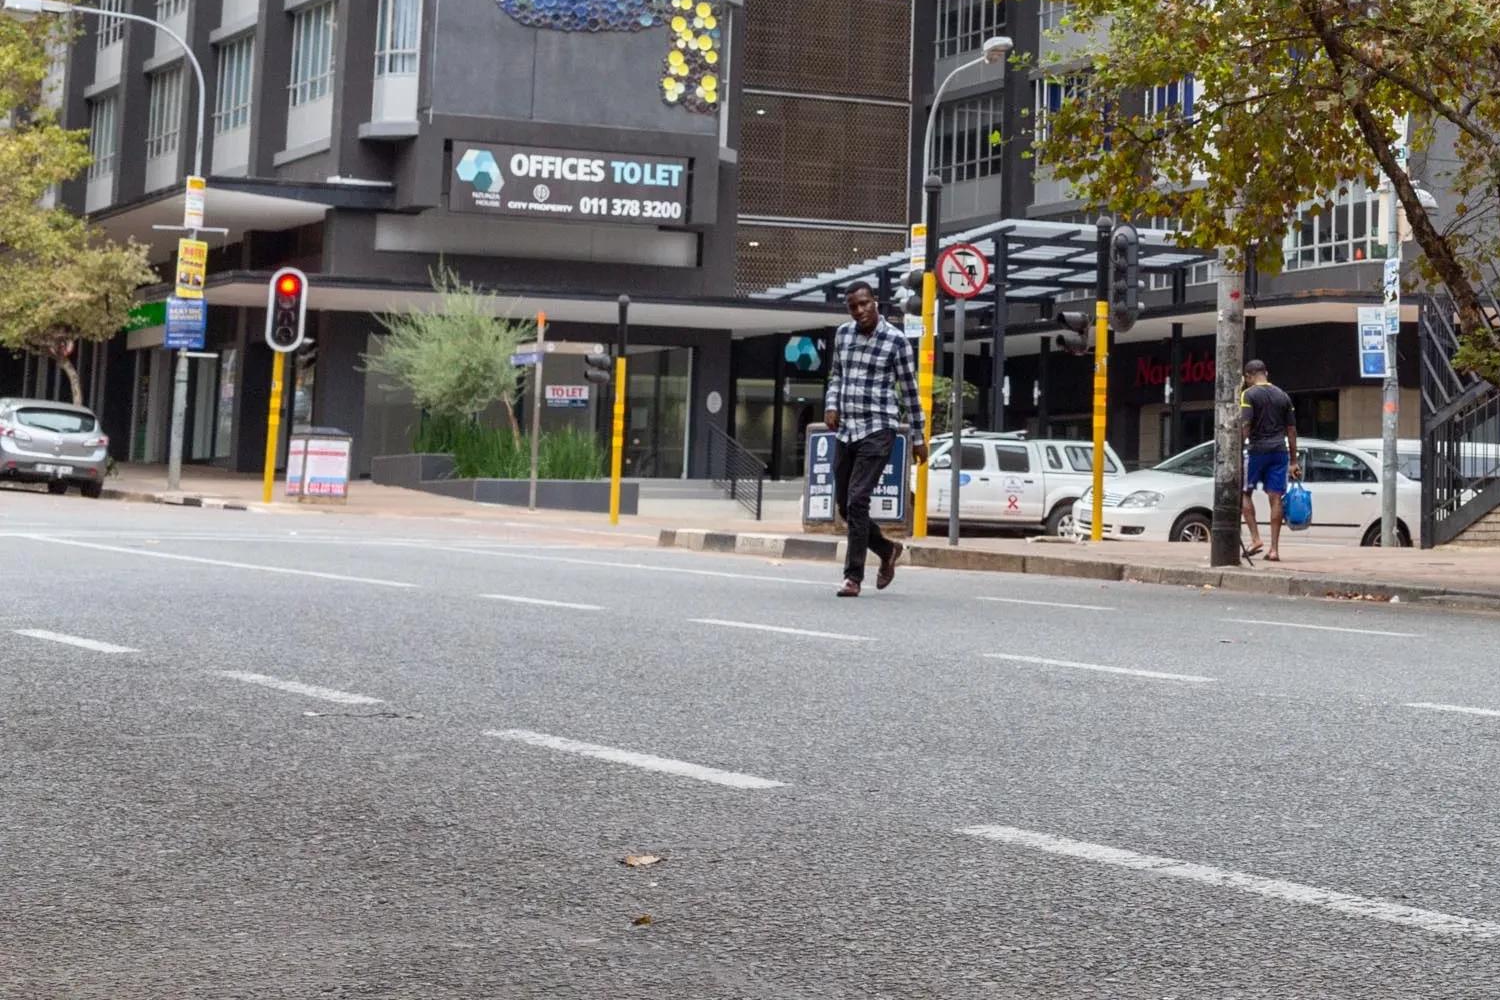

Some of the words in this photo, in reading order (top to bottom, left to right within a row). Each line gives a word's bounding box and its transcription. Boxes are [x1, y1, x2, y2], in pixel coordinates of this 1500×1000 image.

[510, 153, 605, 182] OFFICES
[611, 160, 642, 184] TO
[643, 164, 683, 187] LET
[507, 201, 527, 209] CITY
[528, 202, 573, 213] PROPERTY
[579, 196, 607, 215] 011
[611, 198, 641, 217] 378
[642, 201, 682, 219] 3200
[551, 387, 565, 397] TO
[566, 387, 584, 397] LET
